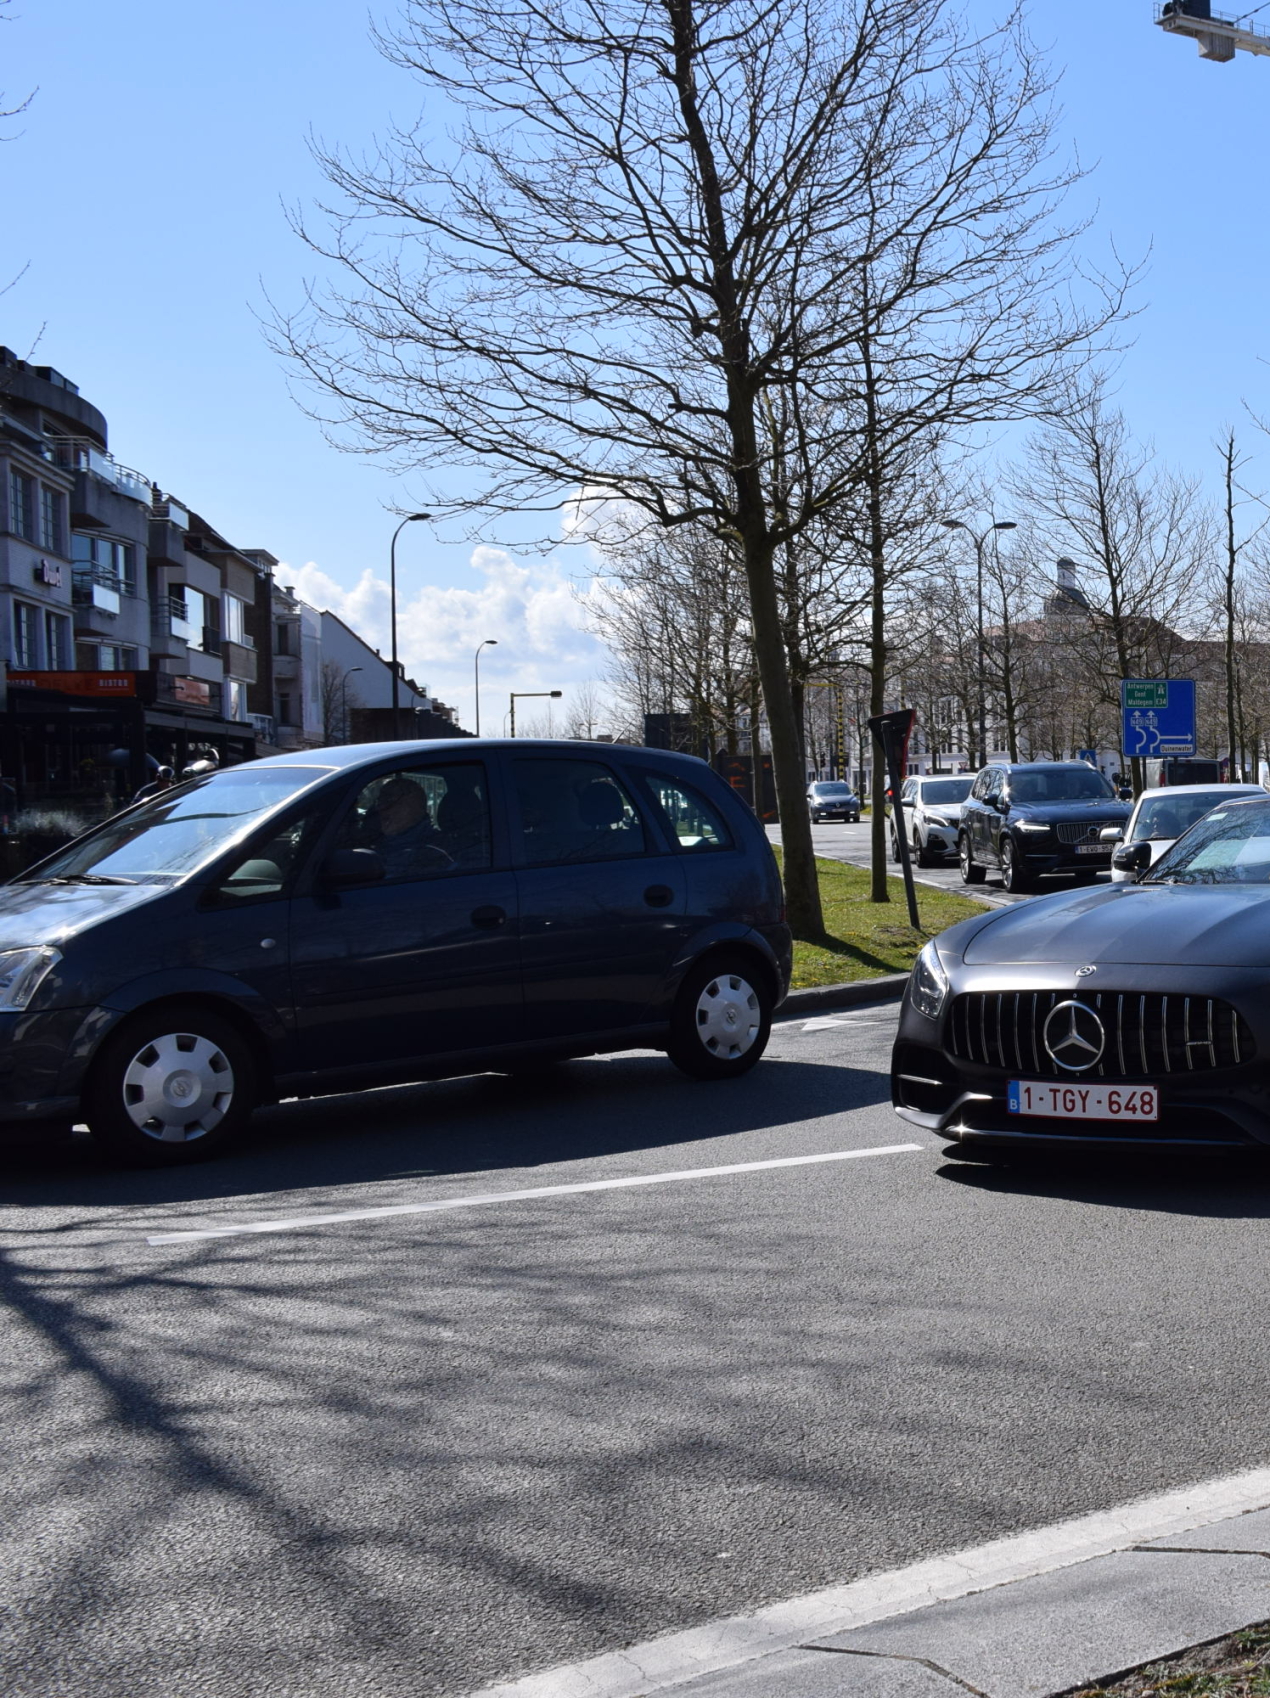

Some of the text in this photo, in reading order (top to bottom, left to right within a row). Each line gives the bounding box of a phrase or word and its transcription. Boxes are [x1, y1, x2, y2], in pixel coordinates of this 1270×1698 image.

[1127, 683, 1154, 691] Antwerpen
[1128, 699, 1153, 707] Maldegem
[1010, 1098, 1018, 1110] B
[1024, 1086, 1154, 1116] 1-TGY-648
